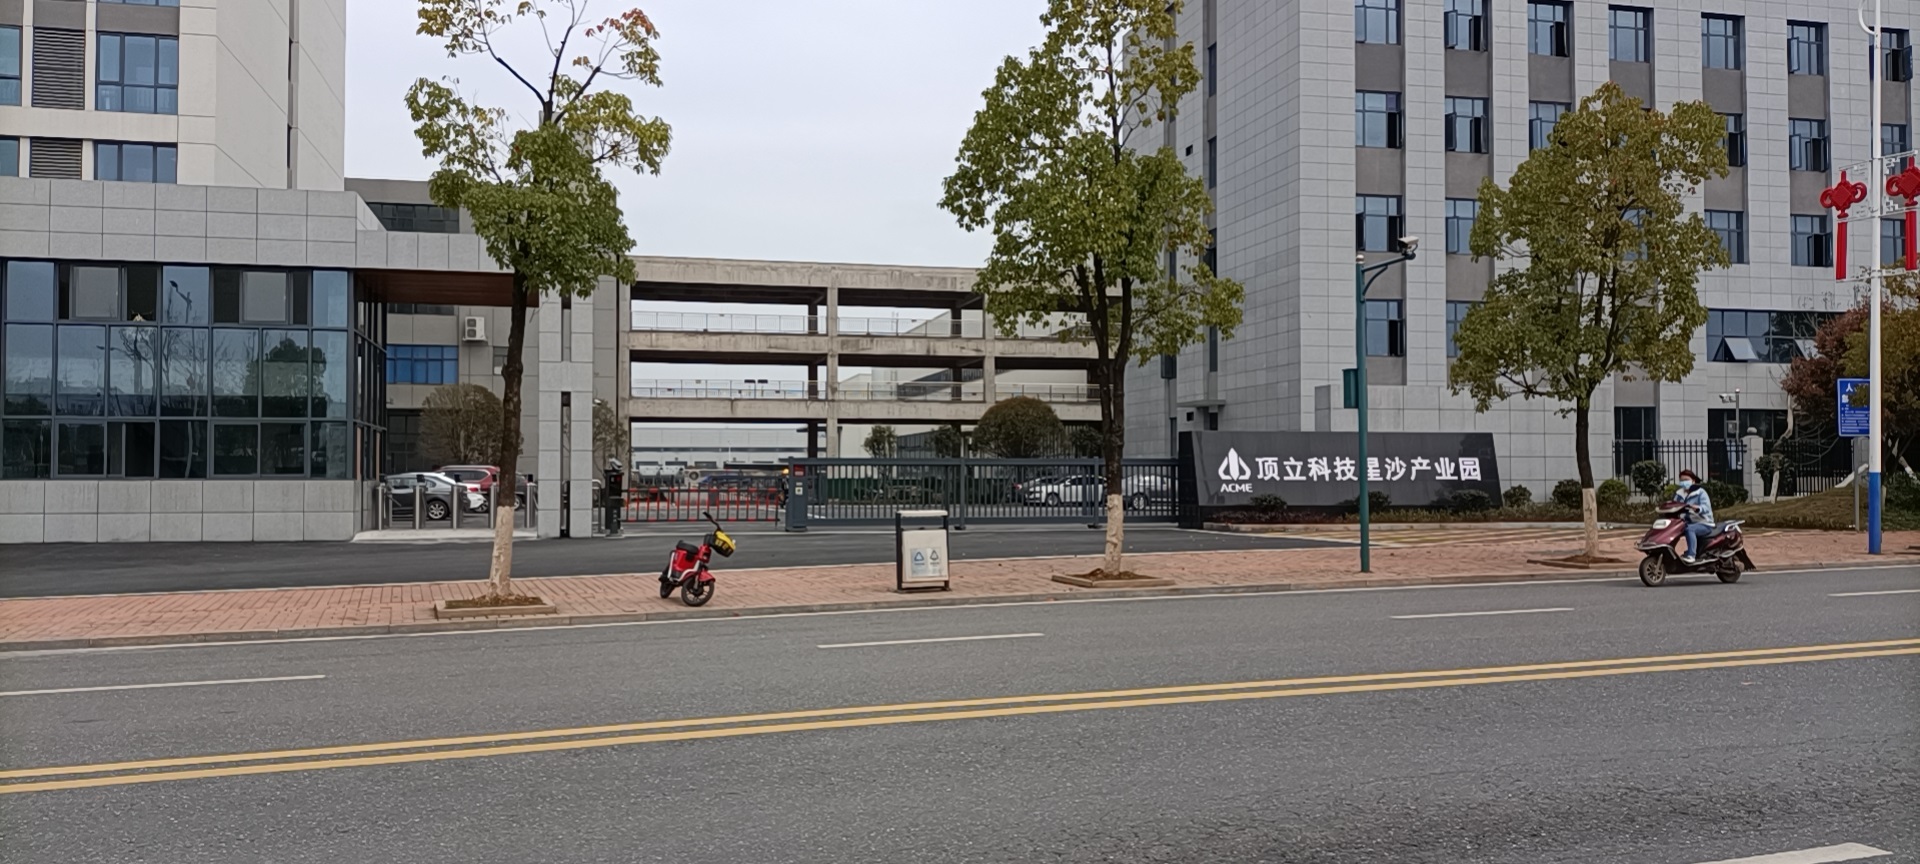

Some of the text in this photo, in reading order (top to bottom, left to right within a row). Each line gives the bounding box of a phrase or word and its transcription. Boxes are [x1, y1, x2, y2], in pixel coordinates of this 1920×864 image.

[1255, 456, 1482, 481] 顶立科技星沙产业园
[1220, 483, 1253, 493] ACME
